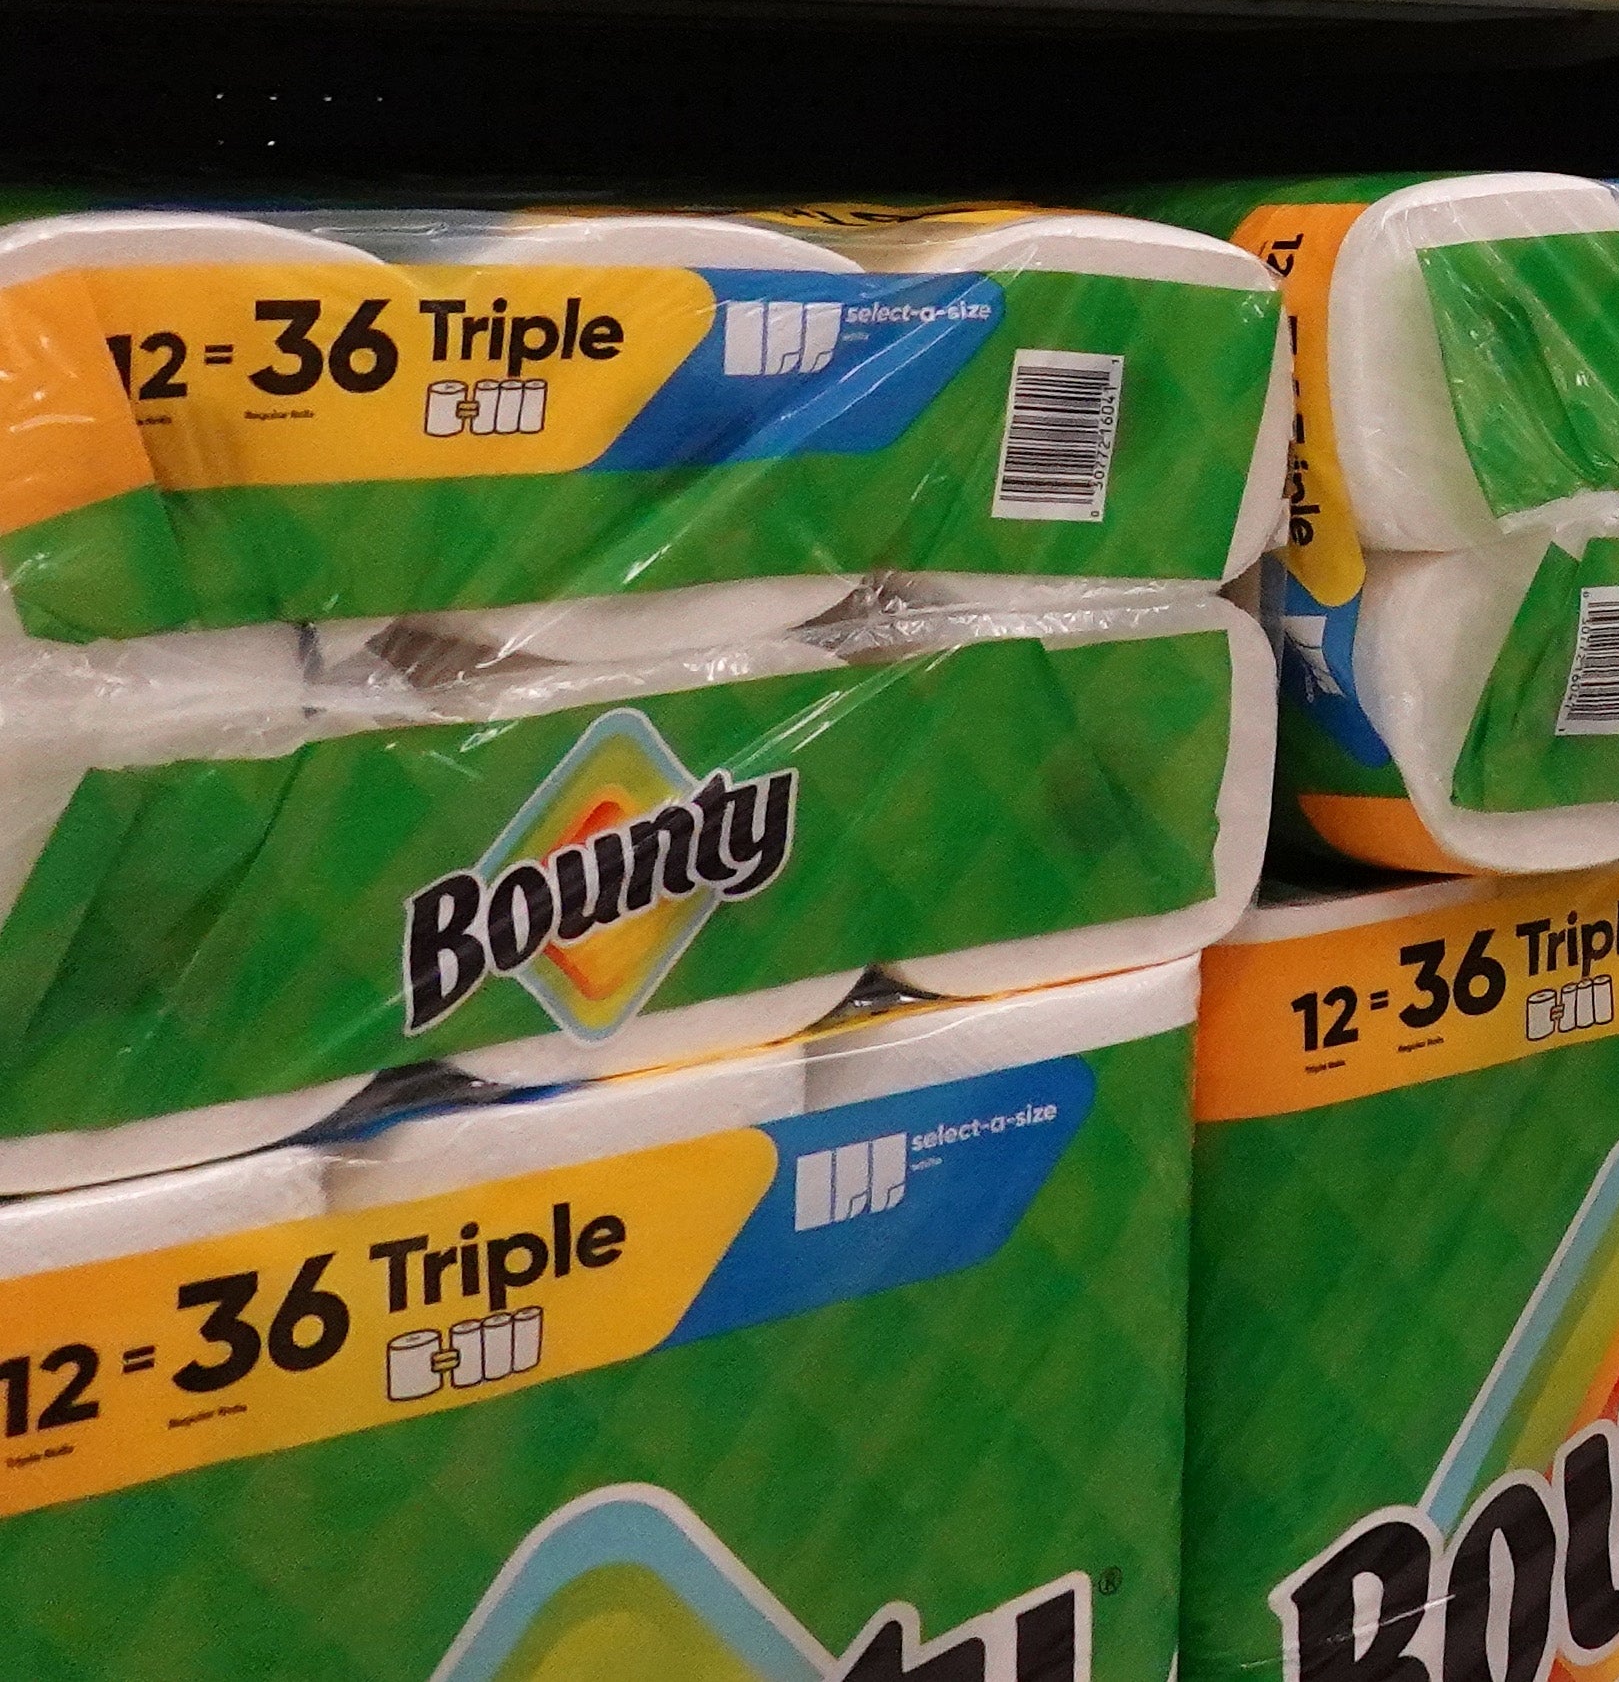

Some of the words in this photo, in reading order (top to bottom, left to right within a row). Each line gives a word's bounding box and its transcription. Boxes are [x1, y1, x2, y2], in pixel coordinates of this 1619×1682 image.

[419, 296, 624, 377] Triple
[844, 300, 992, 323] select-a-size
[408, 770, 796, 1034] Bounty
[910, 1101, 1058, 1152] select-a-size
[369, 1202, 628, 1315] Triple
